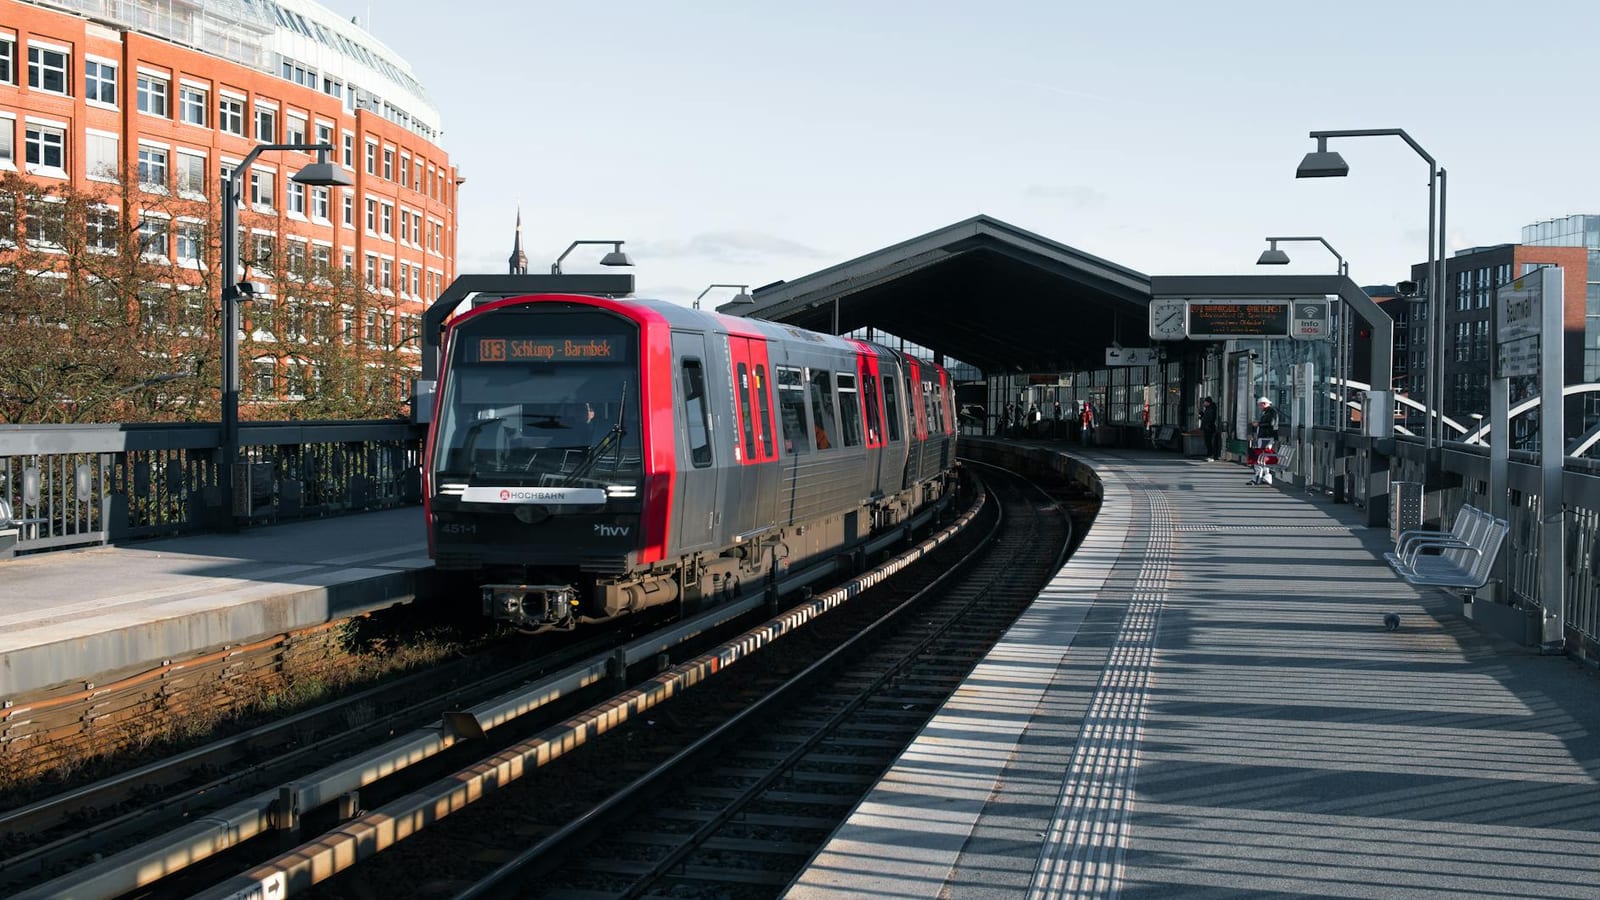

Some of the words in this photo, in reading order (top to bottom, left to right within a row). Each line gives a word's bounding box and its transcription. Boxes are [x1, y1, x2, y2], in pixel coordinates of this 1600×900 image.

[511, 340, 554, 359] Schlump
[564, 340, 611, 357] Barmbek
[511, 491, 565, 500] HOCHBAHN
[441, 524, 477, 534] 451-1
